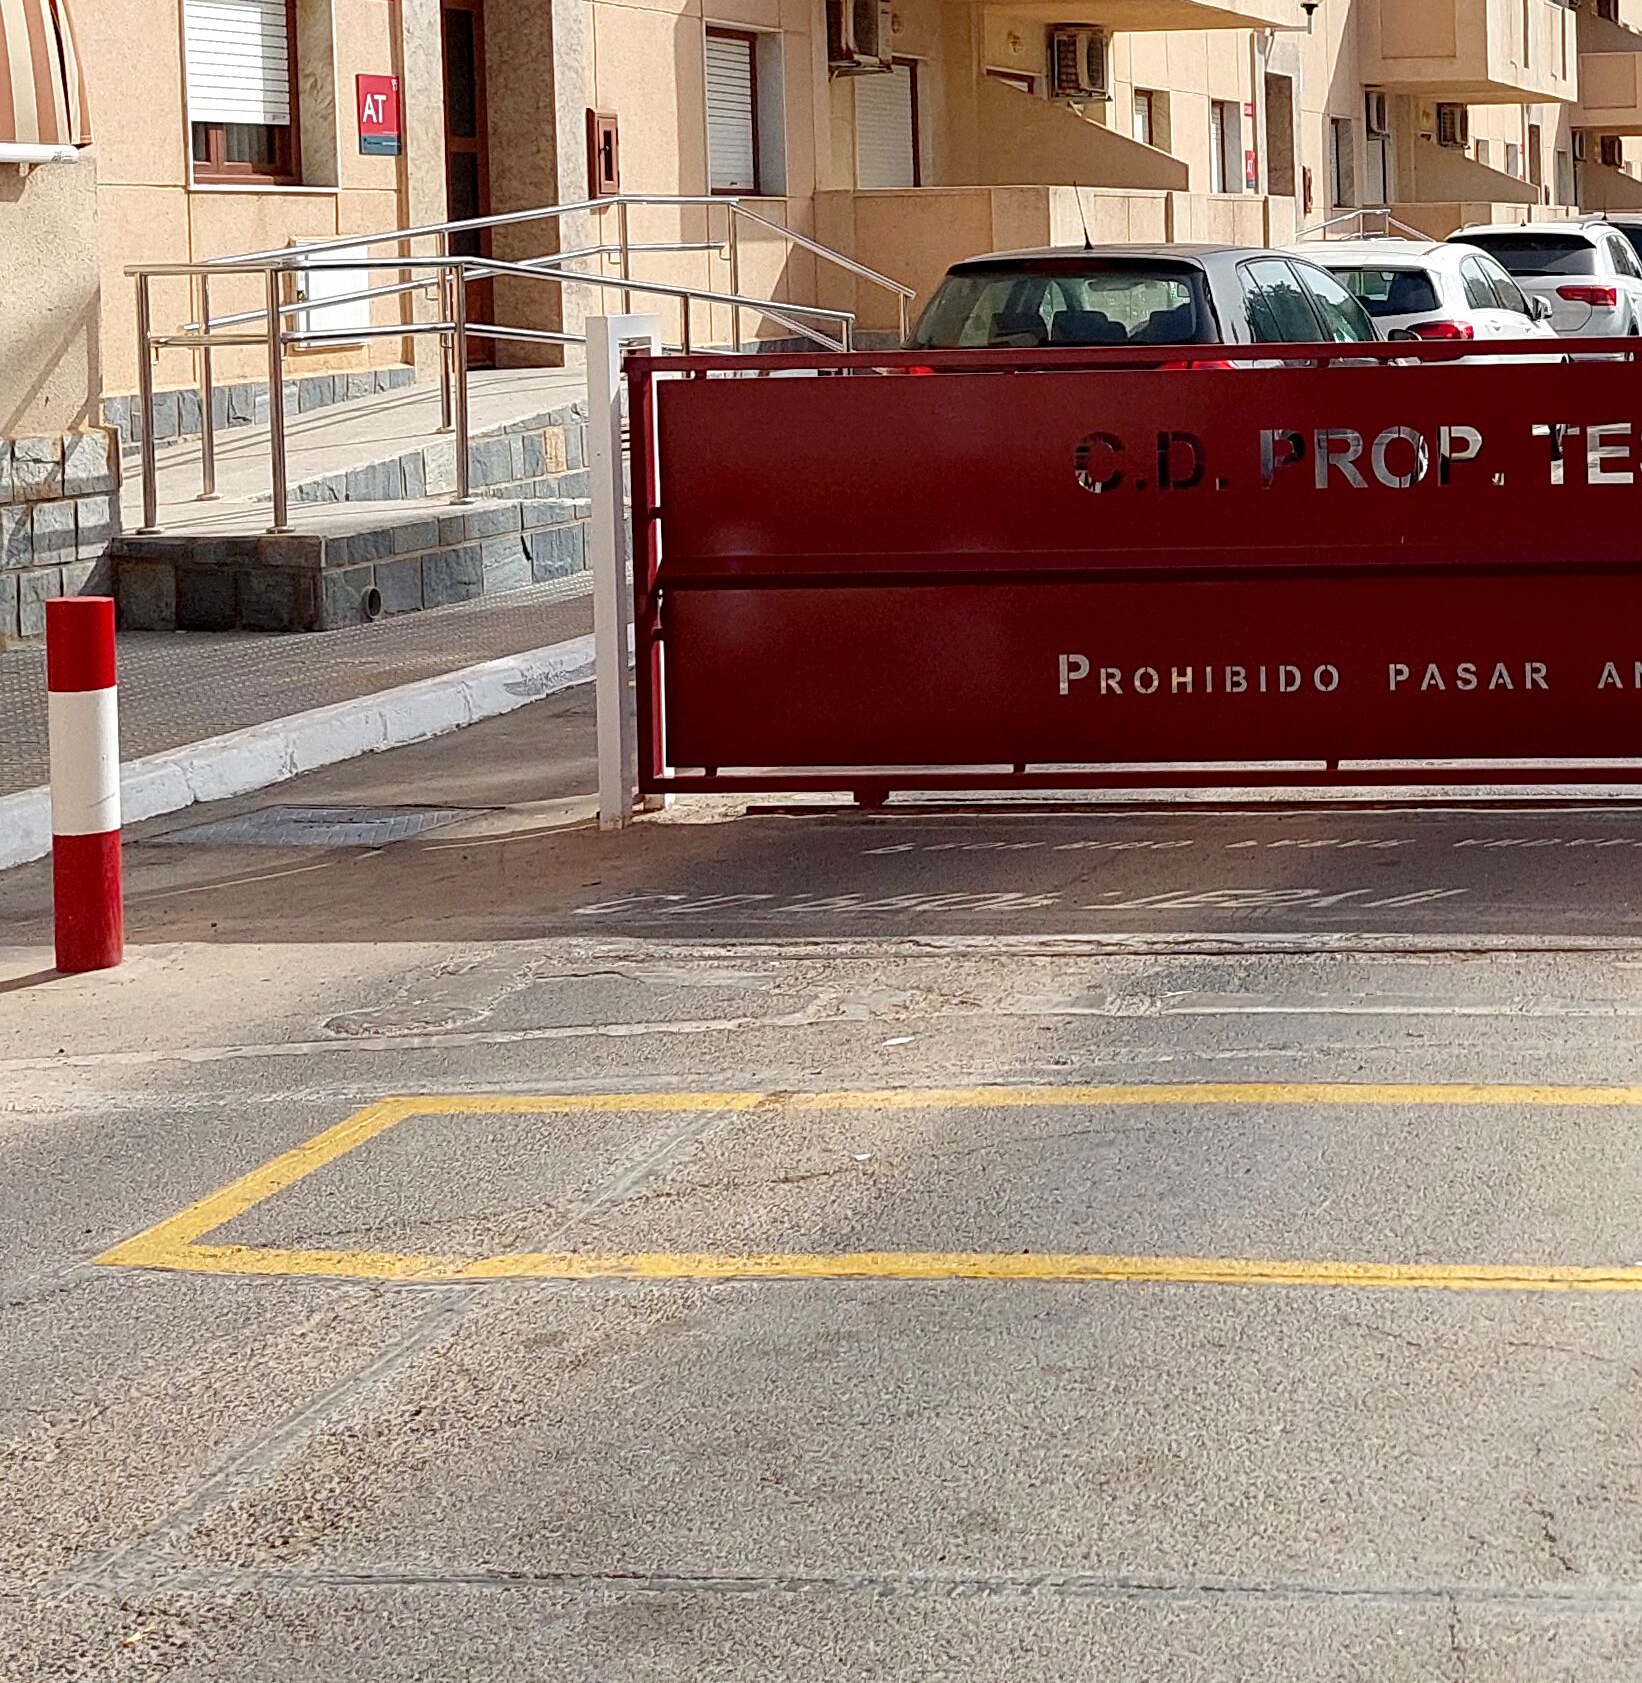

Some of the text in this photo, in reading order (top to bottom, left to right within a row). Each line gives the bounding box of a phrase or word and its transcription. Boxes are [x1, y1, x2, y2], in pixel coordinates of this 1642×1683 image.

[362, 93, 387, 123] AT
[1074, 430, 1229, 494] C.D.
[1259, 424, 1505, 492] PROP.
[1388, 662, 1549, 691] PASAR
